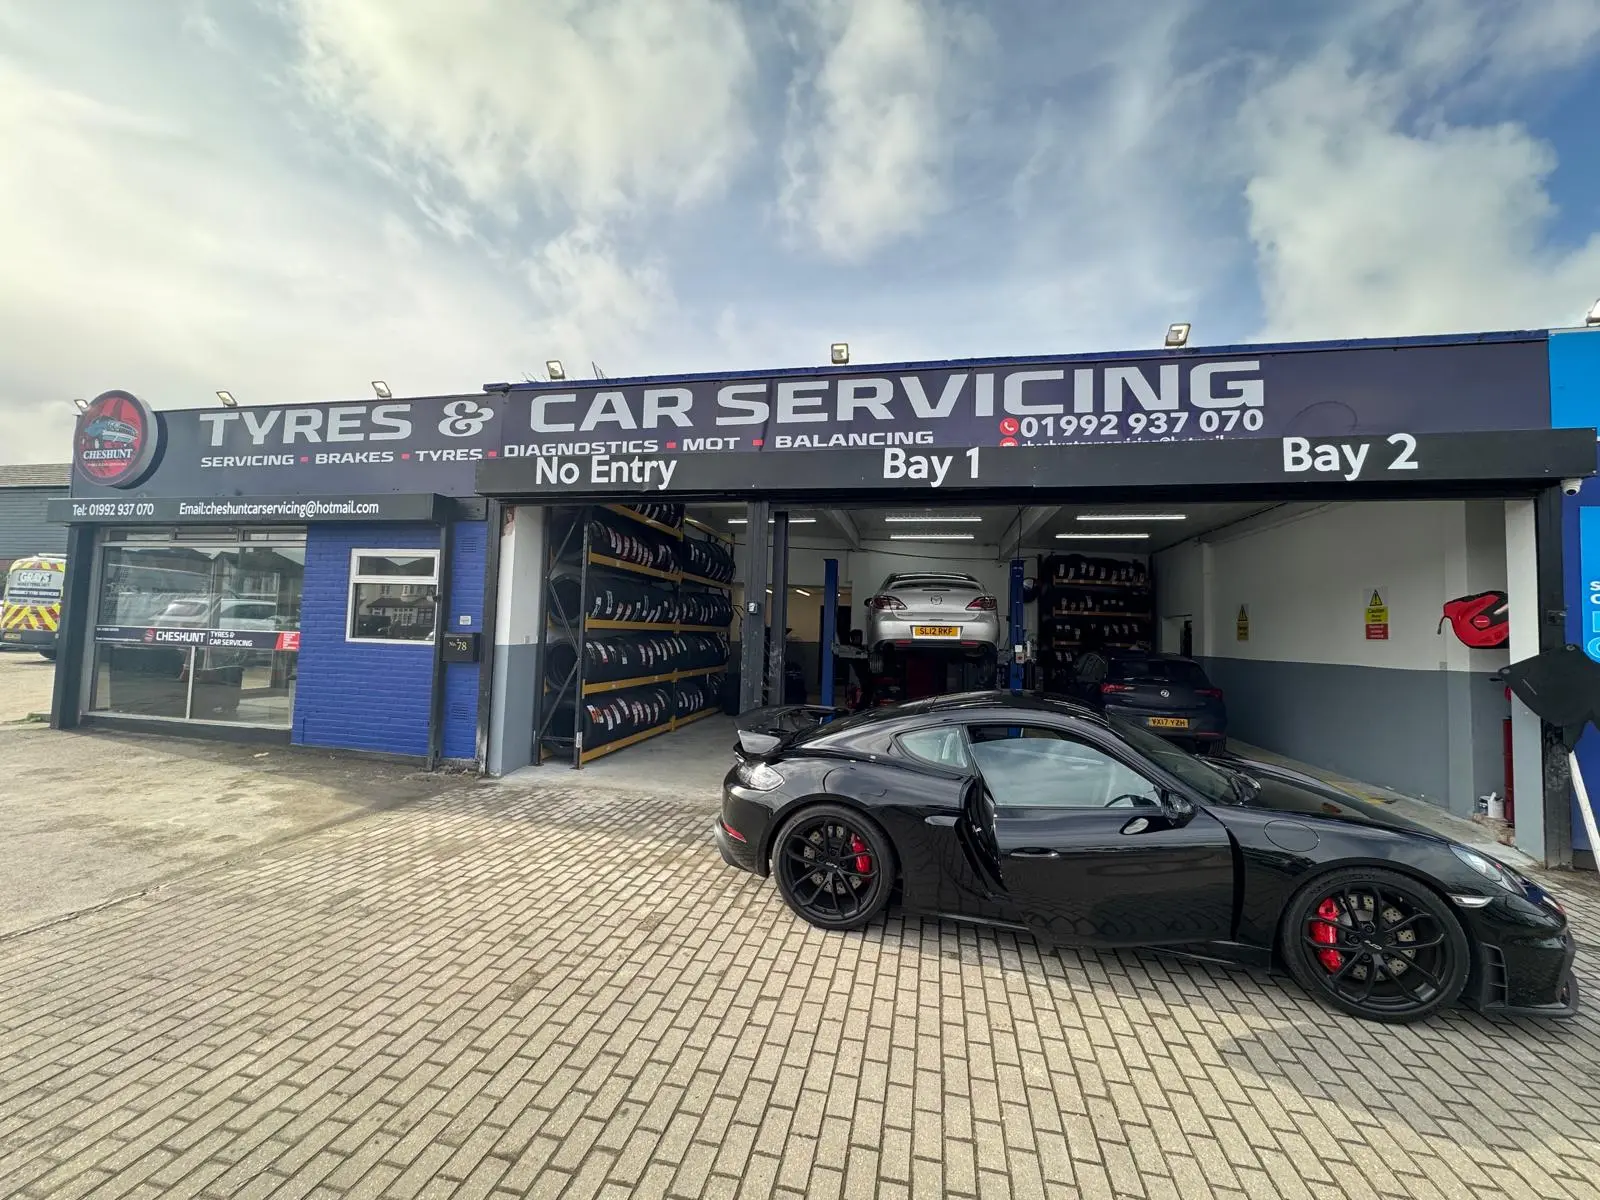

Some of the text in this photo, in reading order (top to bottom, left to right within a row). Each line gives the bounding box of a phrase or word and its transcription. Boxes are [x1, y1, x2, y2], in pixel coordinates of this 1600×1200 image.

[529, 360, 1265, 433] CAR SERVICING
[199, 399, 495, 448] TYRES &
[1020, 408, 1265, 439] 01992 937 070
[83, 448, 134, 460] CHESHUNT
[200, 430, 935, 469] SERVICING BRAKES TYRES DIAGNOSTICS MOT BALANCING
[1282, 433, 1419, 482] Bay 2
[535, 454, 678, 491] No Entry
[882, 447, 981, 488] Bay 1
[89, 503, 116, 517] 01992
[117, 503, 136, 517] 937
[136, 502, 155, 516] 070
[155, 631, 206, 643] CHESHUNT
[209, 638, 253, 647] CAR SERVICING
[210, 630, 230, 638] TYRES
[920, 627, 952, 636] SL12 RKF
[456, 642, 467, 651] 78
